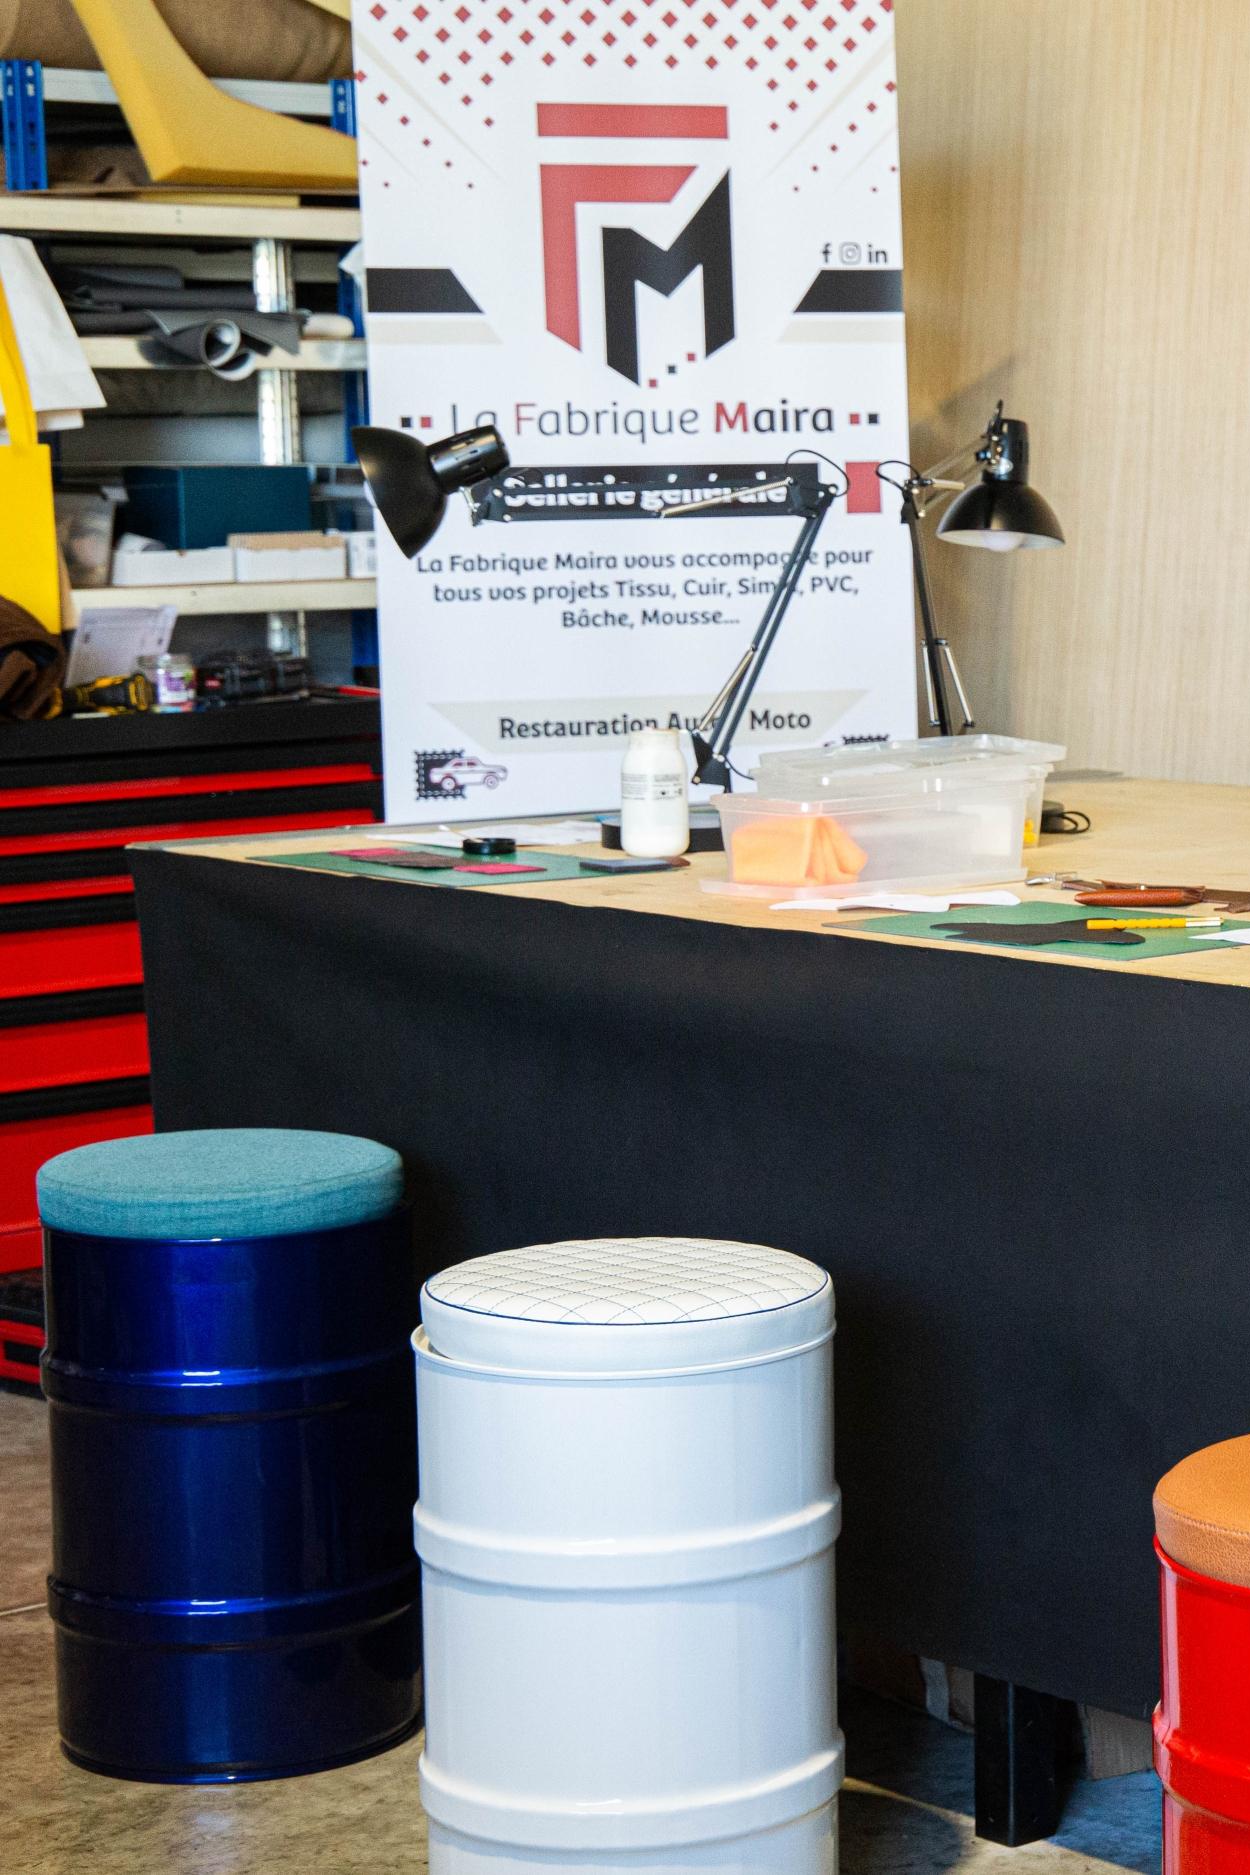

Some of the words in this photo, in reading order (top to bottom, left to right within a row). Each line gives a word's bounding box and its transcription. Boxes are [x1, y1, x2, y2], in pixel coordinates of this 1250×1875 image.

[515, 401, 699, 444] Fabrique
[714, 398, 834, 433] Maira
[416, 557, 443, 573] La
[450, 553, 549, 575] Fabrique
[554, 550, 618, 570] Maira
[624, 553, 675, 569] vous
[825, 550, 873, 569] pour
[433, 584, 482, 602] tous
[489, 585, 527, 600] vos
[532, 581, 609, 604] projets
[615, 579, 677, 600] Tissu,
[683, 577, 732, 598] Cuir,
[811, 575, 859, 595] PVC,
[562, 608, 635, 629] Bâche,
[641, 608, 740, 626] Mousse...
[499, 713, 658, 739] Restauration
[750, 709, 811, 731] Moto
